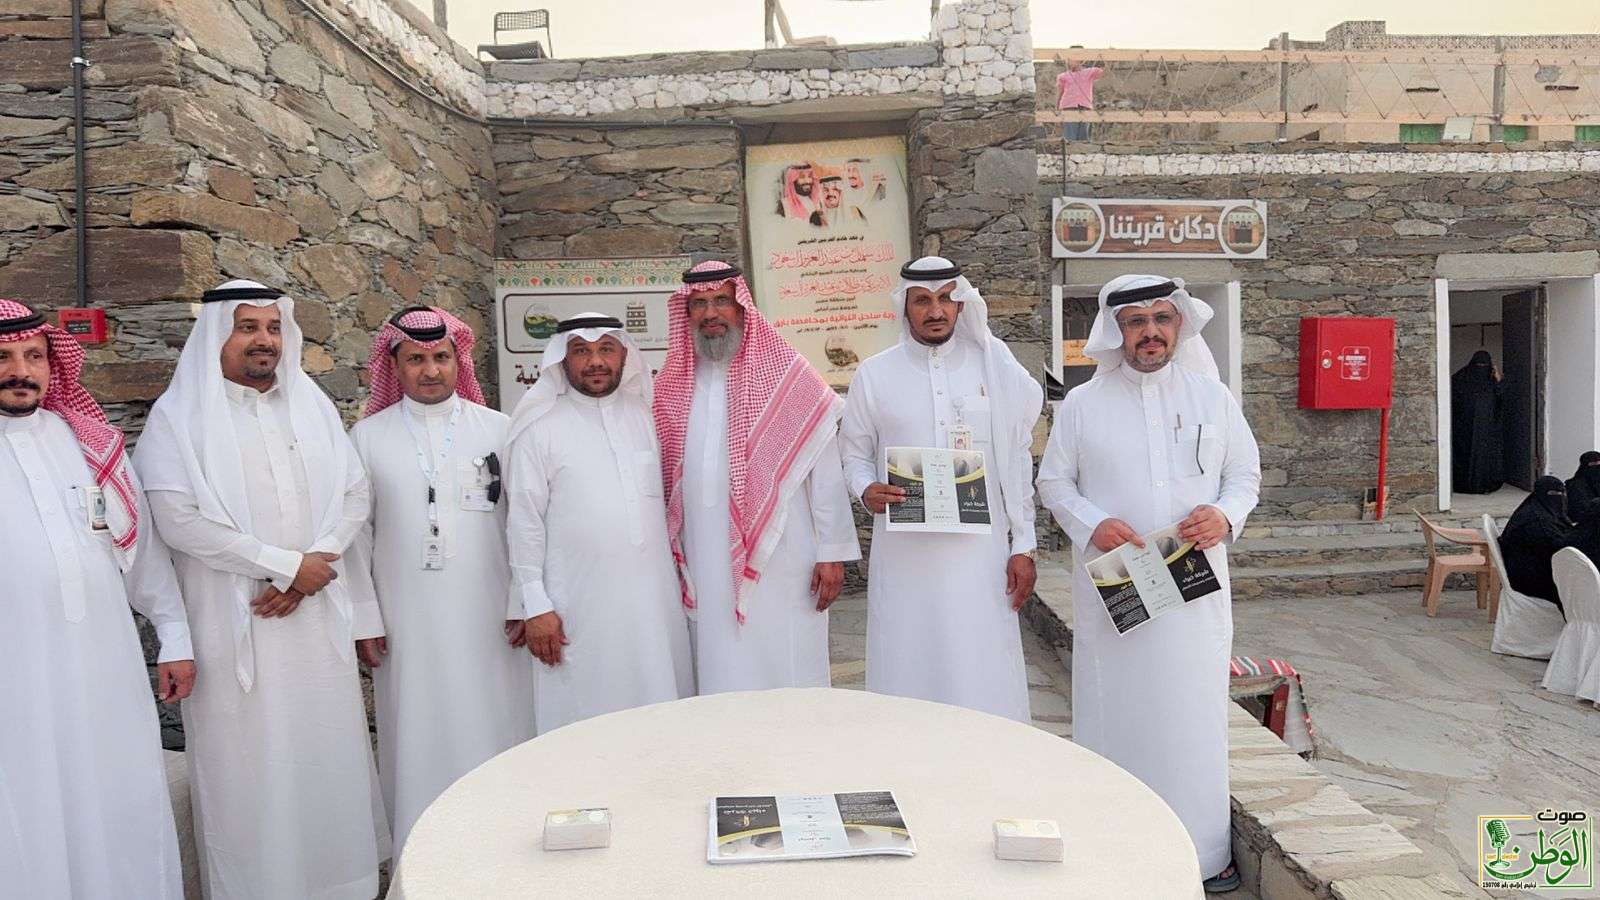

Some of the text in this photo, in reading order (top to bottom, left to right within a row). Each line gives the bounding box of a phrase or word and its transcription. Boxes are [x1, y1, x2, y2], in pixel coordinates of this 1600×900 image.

[1109, 214, 1216, 246] دكان قريتنا
[790, 315, 829, 325] بمحافظة
[882, 311, 897, 321] رية
